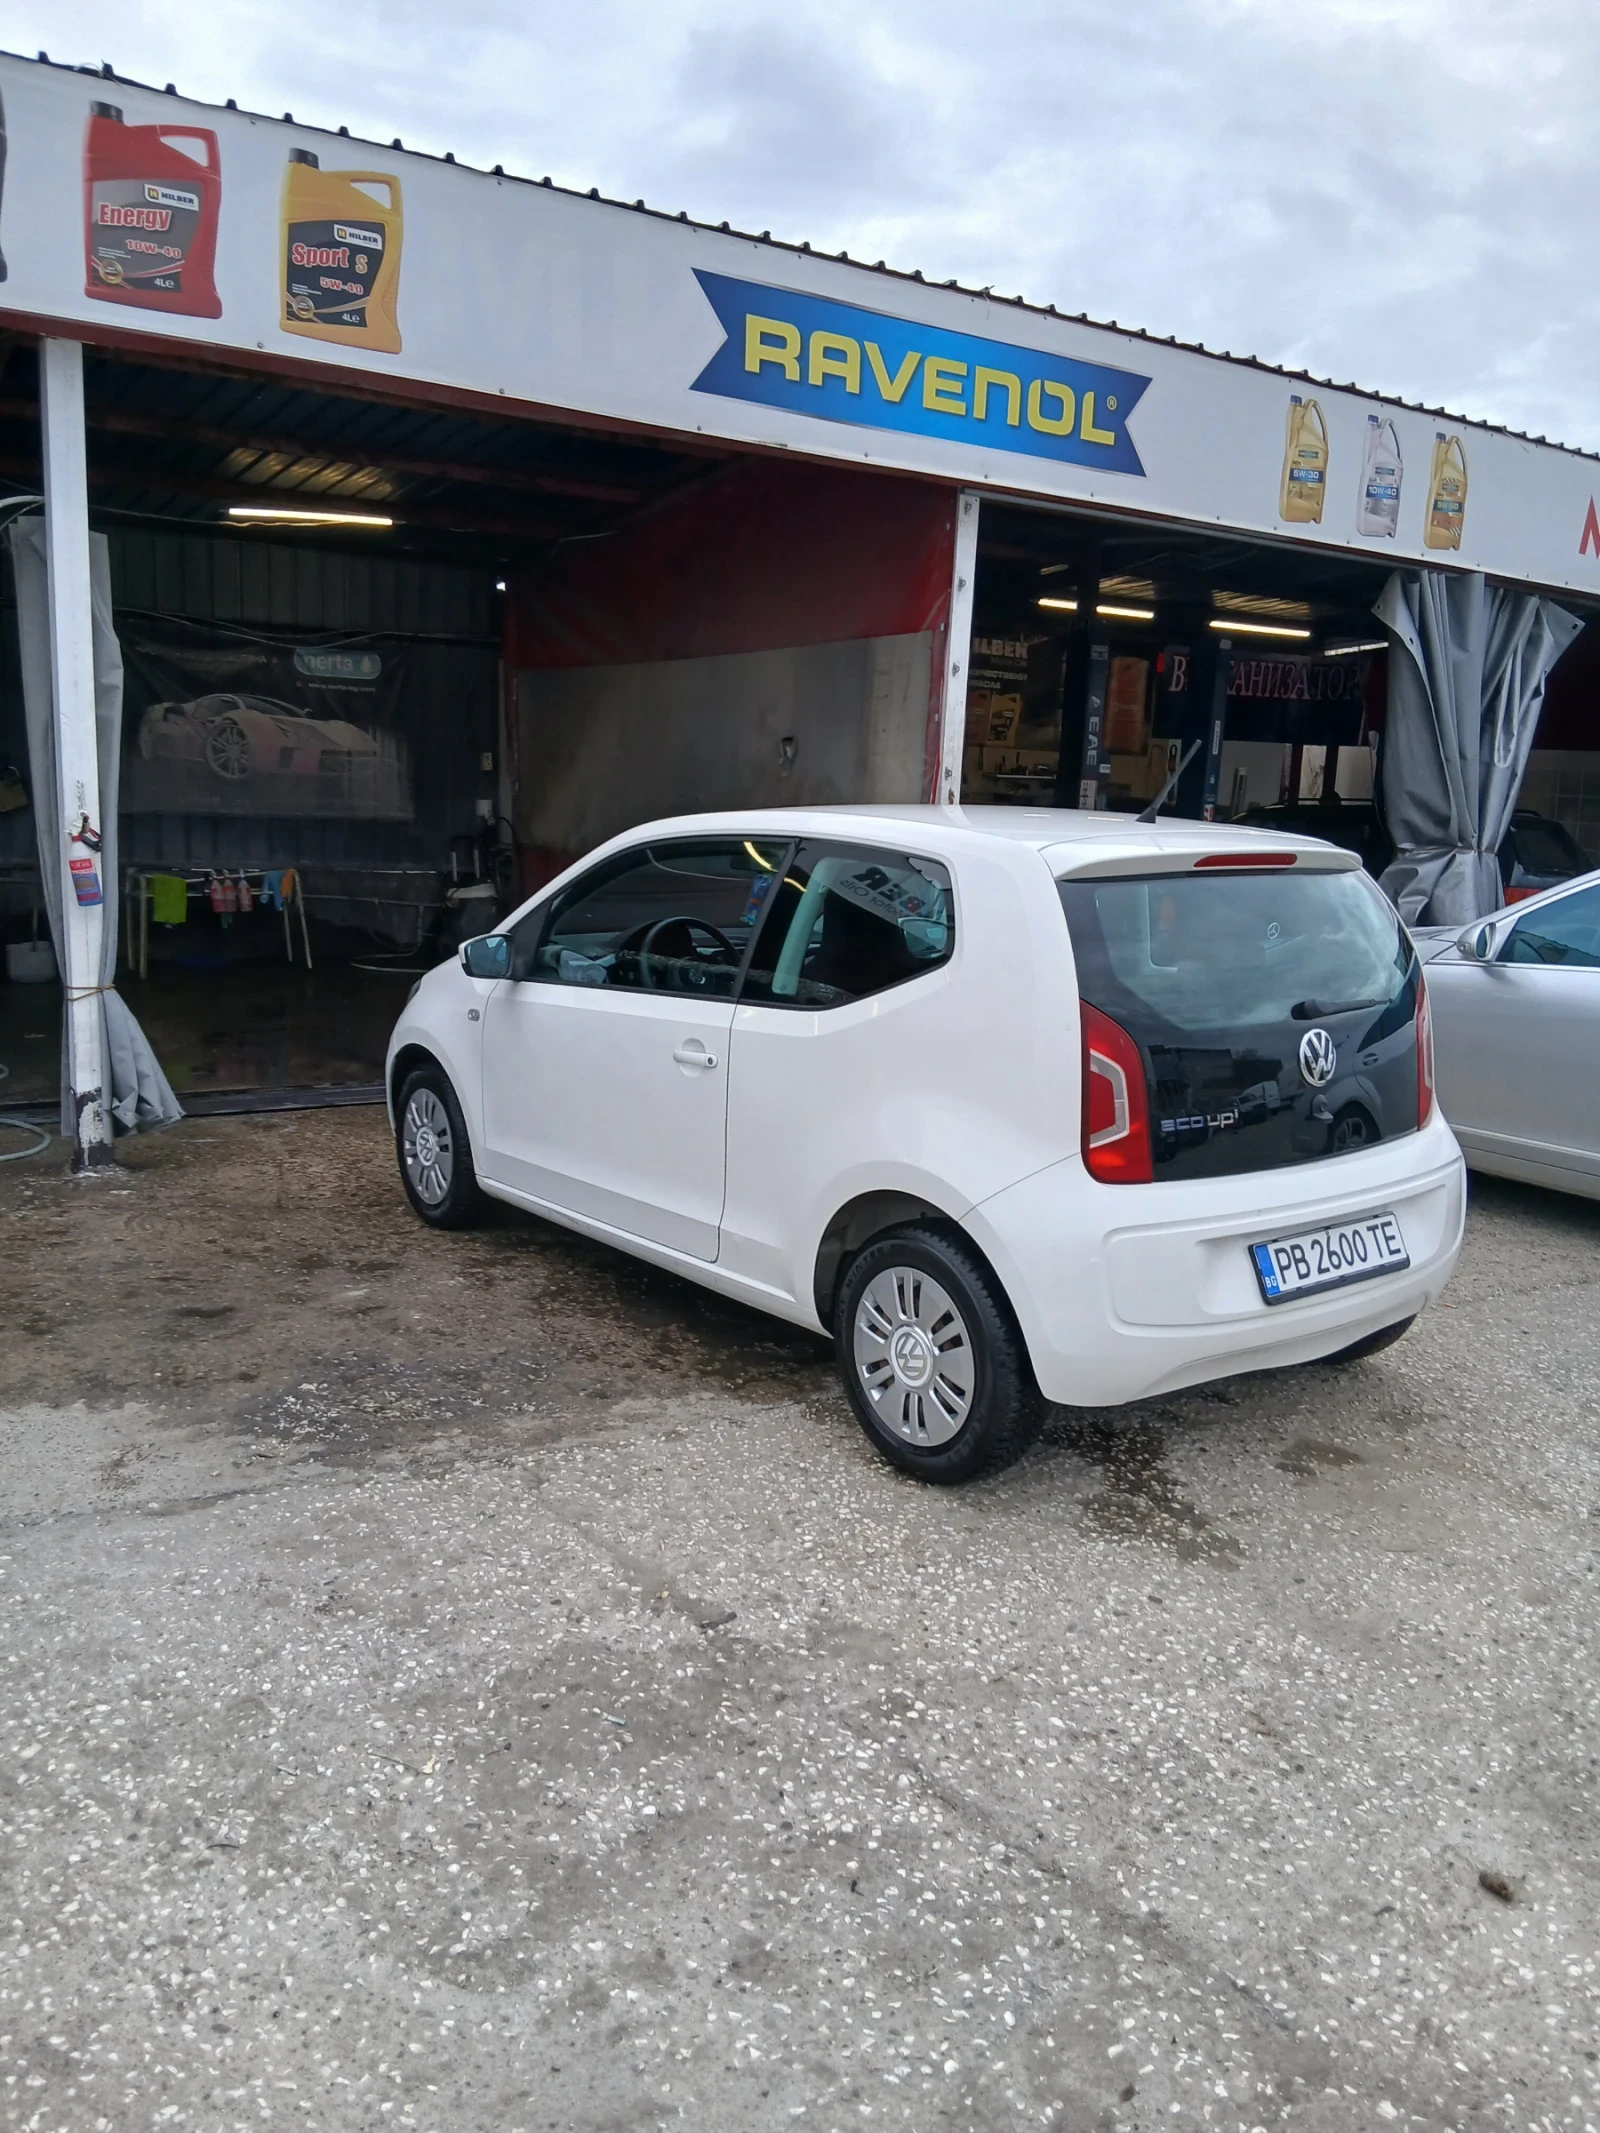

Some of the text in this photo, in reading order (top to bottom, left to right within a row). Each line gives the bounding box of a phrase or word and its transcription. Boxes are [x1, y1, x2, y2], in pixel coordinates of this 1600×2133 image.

[161, 192, 194, 205] HILBER
[98, 203, 172, 231] Energy
[349, 232, 379, 244] HILBER
[125, 239, 182, 259] 10W-40
[292, 242, 368, 274] Sport S
[320, 276, 364, 295] 5W-40
[1293, 469, 1320, 479] 5W-30
[1368, 486, 1397, 496] 10W-40
[974, 637, 1028, 659] ILBER
[1086, 716, 1100, 766] EAE
[1160, 1116, 1204, 1132] eco
[1273, 1220, 1402, 1284] PB 2600 TE
[1265, 1275, 1278, 1288] BG
